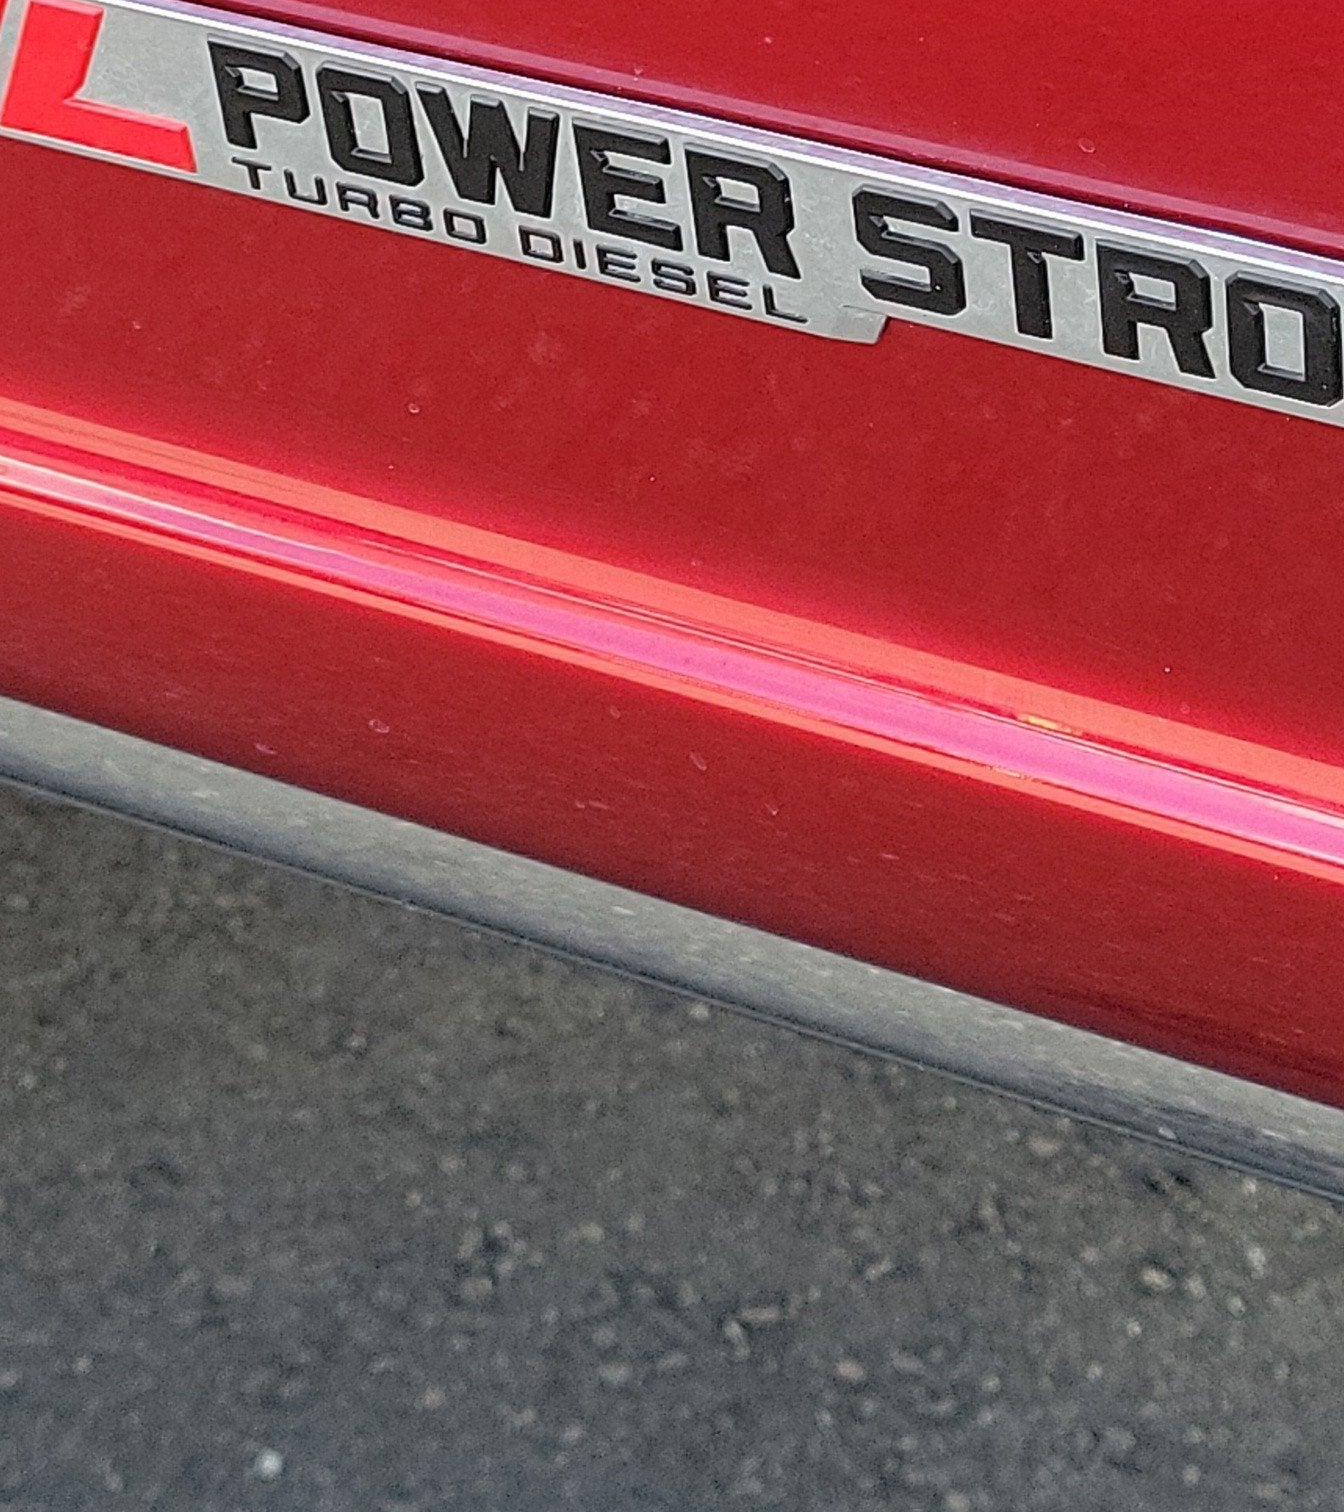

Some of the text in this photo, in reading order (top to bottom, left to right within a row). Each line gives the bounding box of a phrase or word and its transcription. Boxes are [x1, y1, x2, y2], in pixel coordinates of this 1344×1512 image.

[206, 35, 801, 280] POWER
[230, 156, 808, 324] TURBO DIESEL
